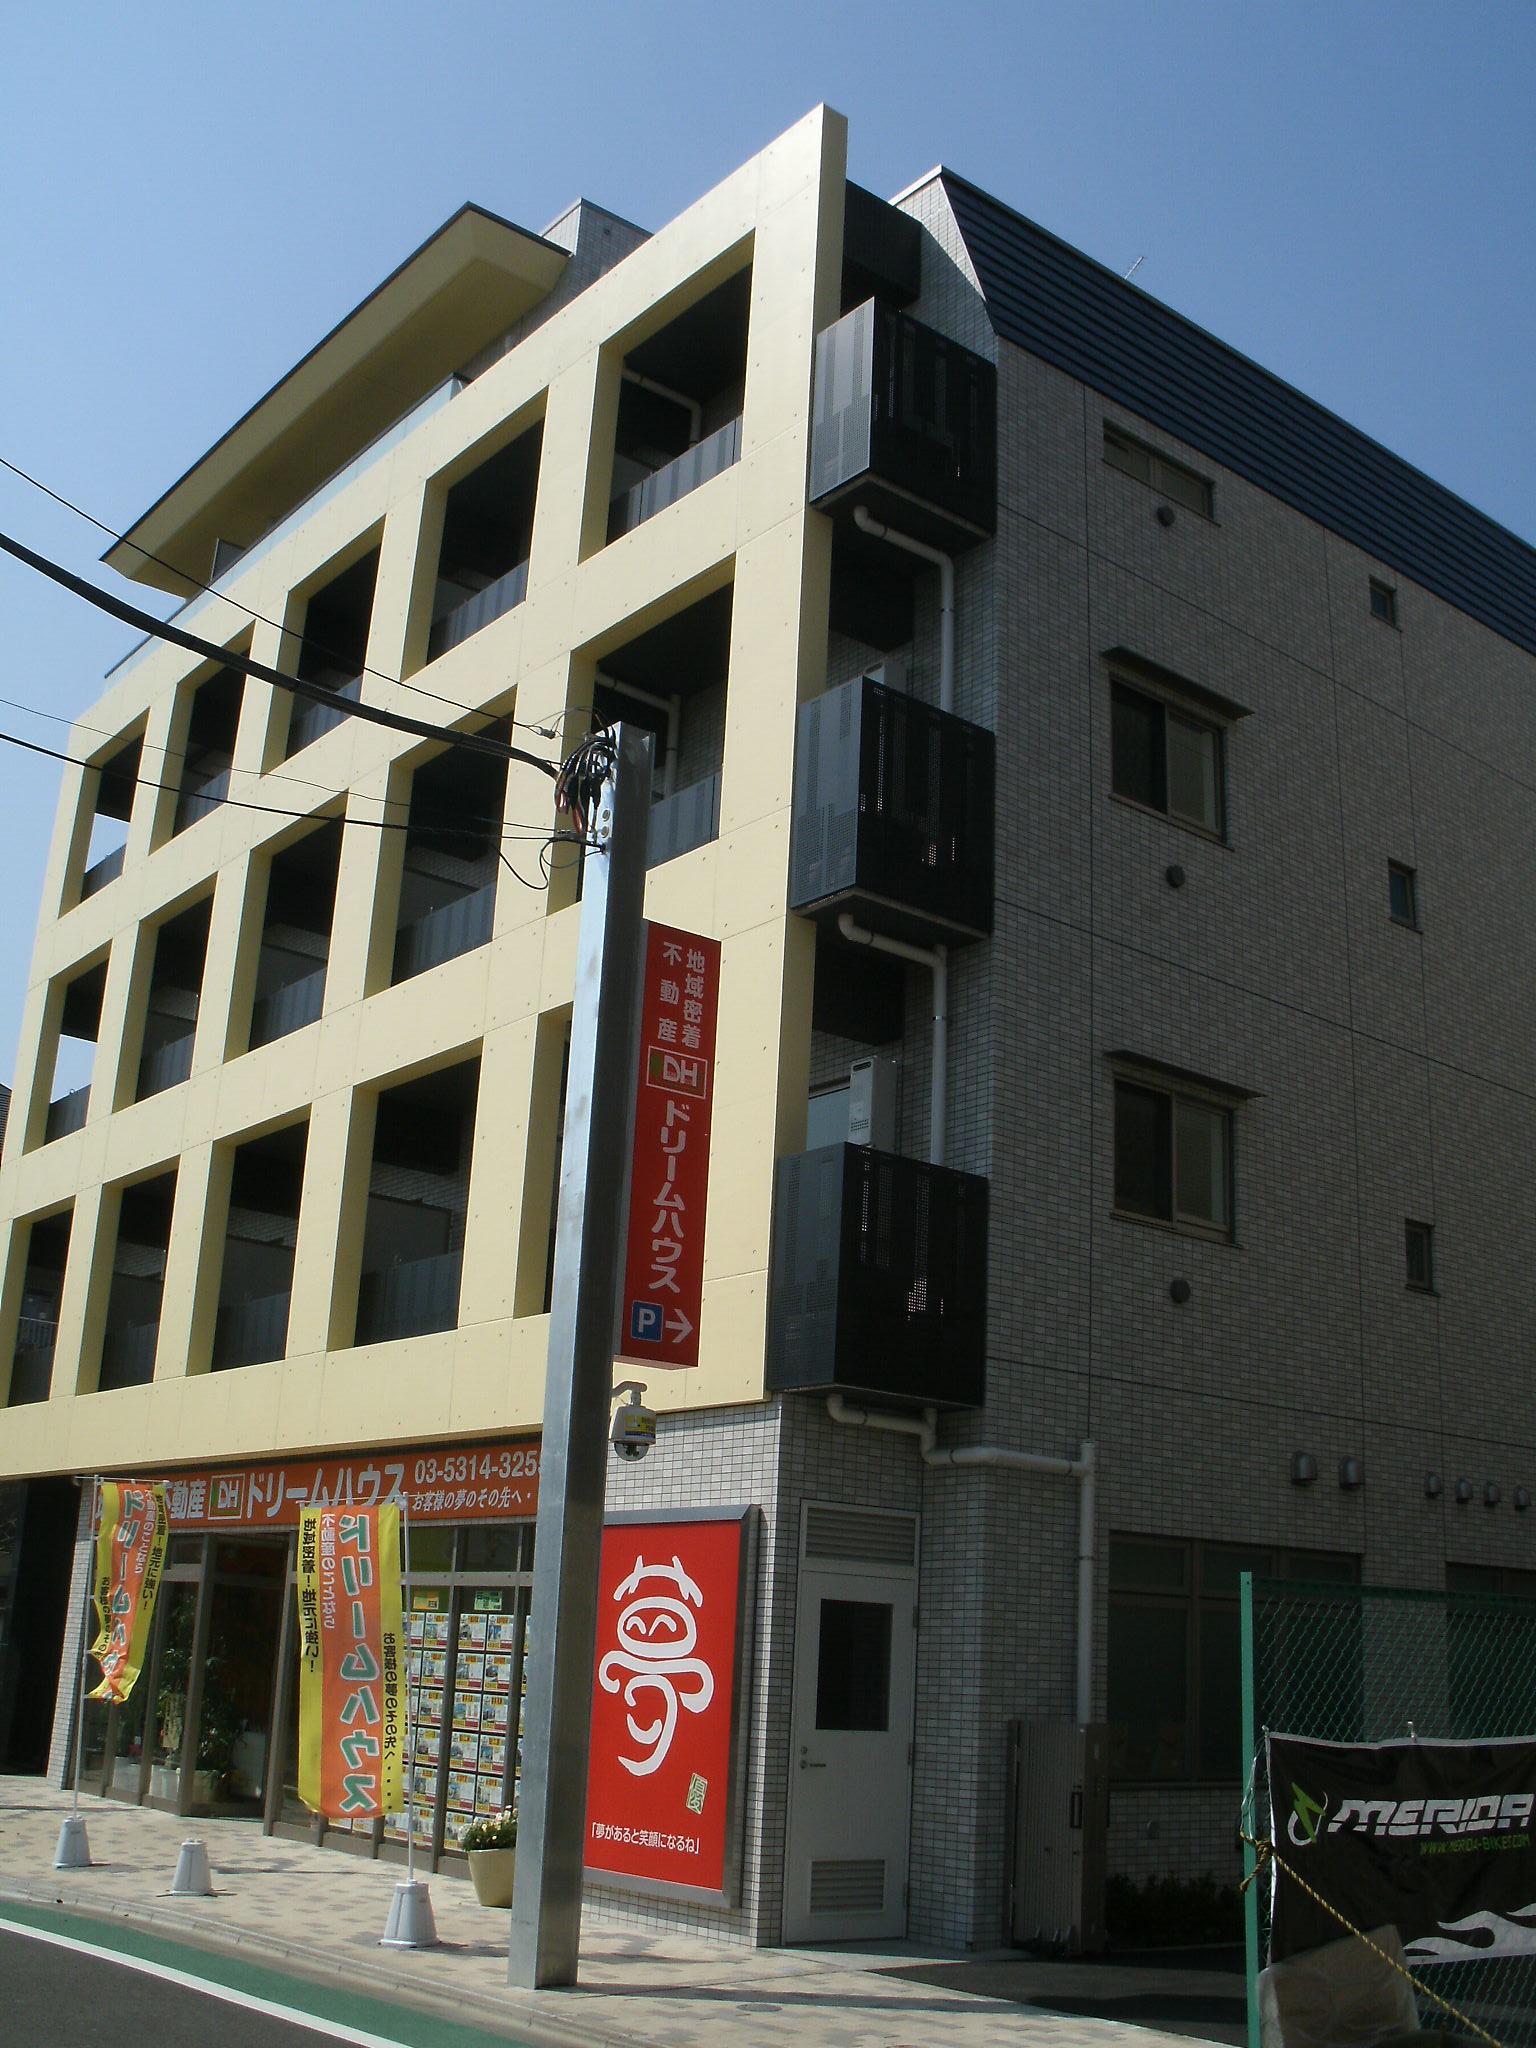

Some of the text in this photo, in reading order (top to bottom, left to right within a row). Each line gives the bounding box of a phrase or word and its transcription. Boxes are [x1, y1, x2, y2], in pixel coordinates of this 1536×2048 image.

[657, 941, 682, 1043] 不動産
[682, 949, 705, 1049] 地域密着
[663, 1055, 698, 1087] DH
[649, 1100, 690, 1293] ドリームハウス
[638, 1308, 656, 1333] P
[414, 1450, 542, 1484] 03-5314-325
[217, 1479, 240, 1509] DH
[246, 1463, 404, 1519] ドリームハウス
[1327, 1793, 1535, 1836] MERIDA
[591, 1821, 700, 1855] 「夢があると笑顔になるね」
